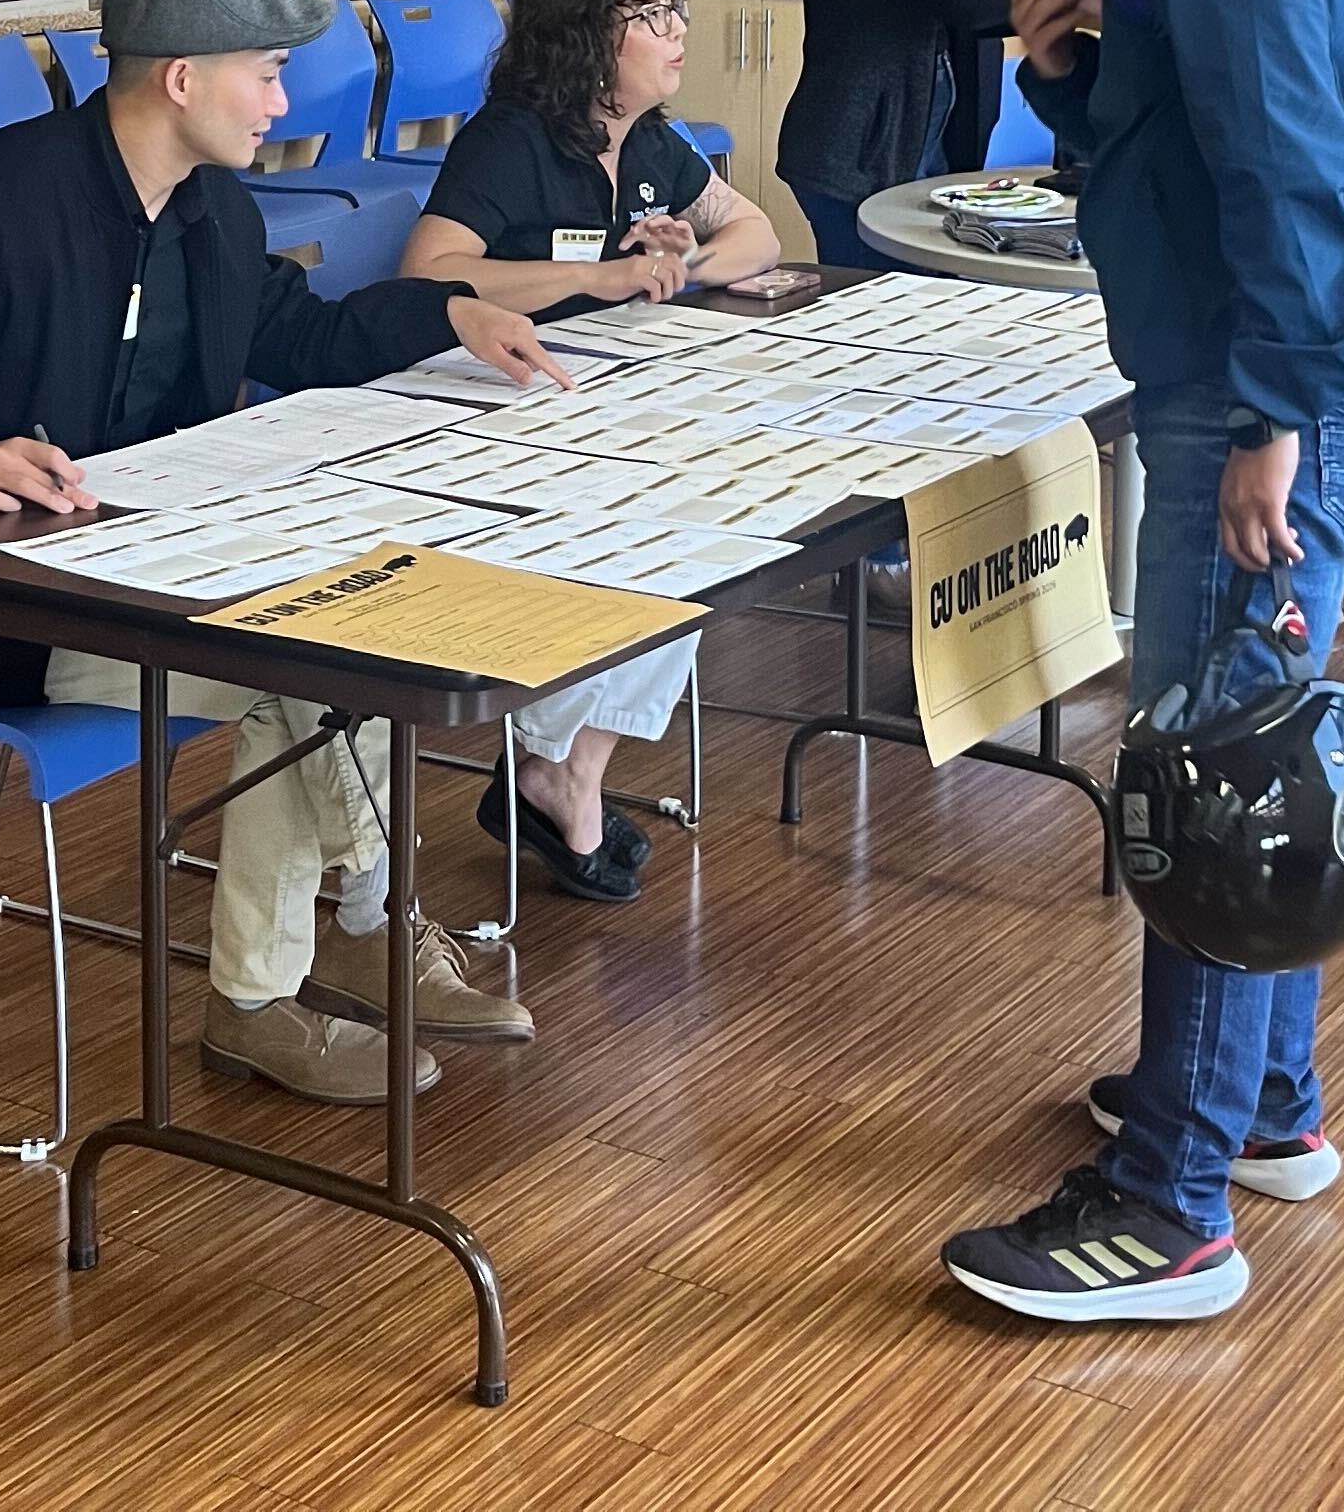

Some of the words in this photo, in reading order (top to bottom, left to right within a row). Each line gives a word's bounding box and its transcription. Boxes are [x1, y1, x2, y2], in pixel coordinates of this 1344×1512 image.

[930, 575, 953, 629] CU
[957, 562, 981, 615] ON
[985, 544, 1015, 601] THE
[1018, 523, 1060, 584] ROAD
[263, 602, 309, 616] ON
